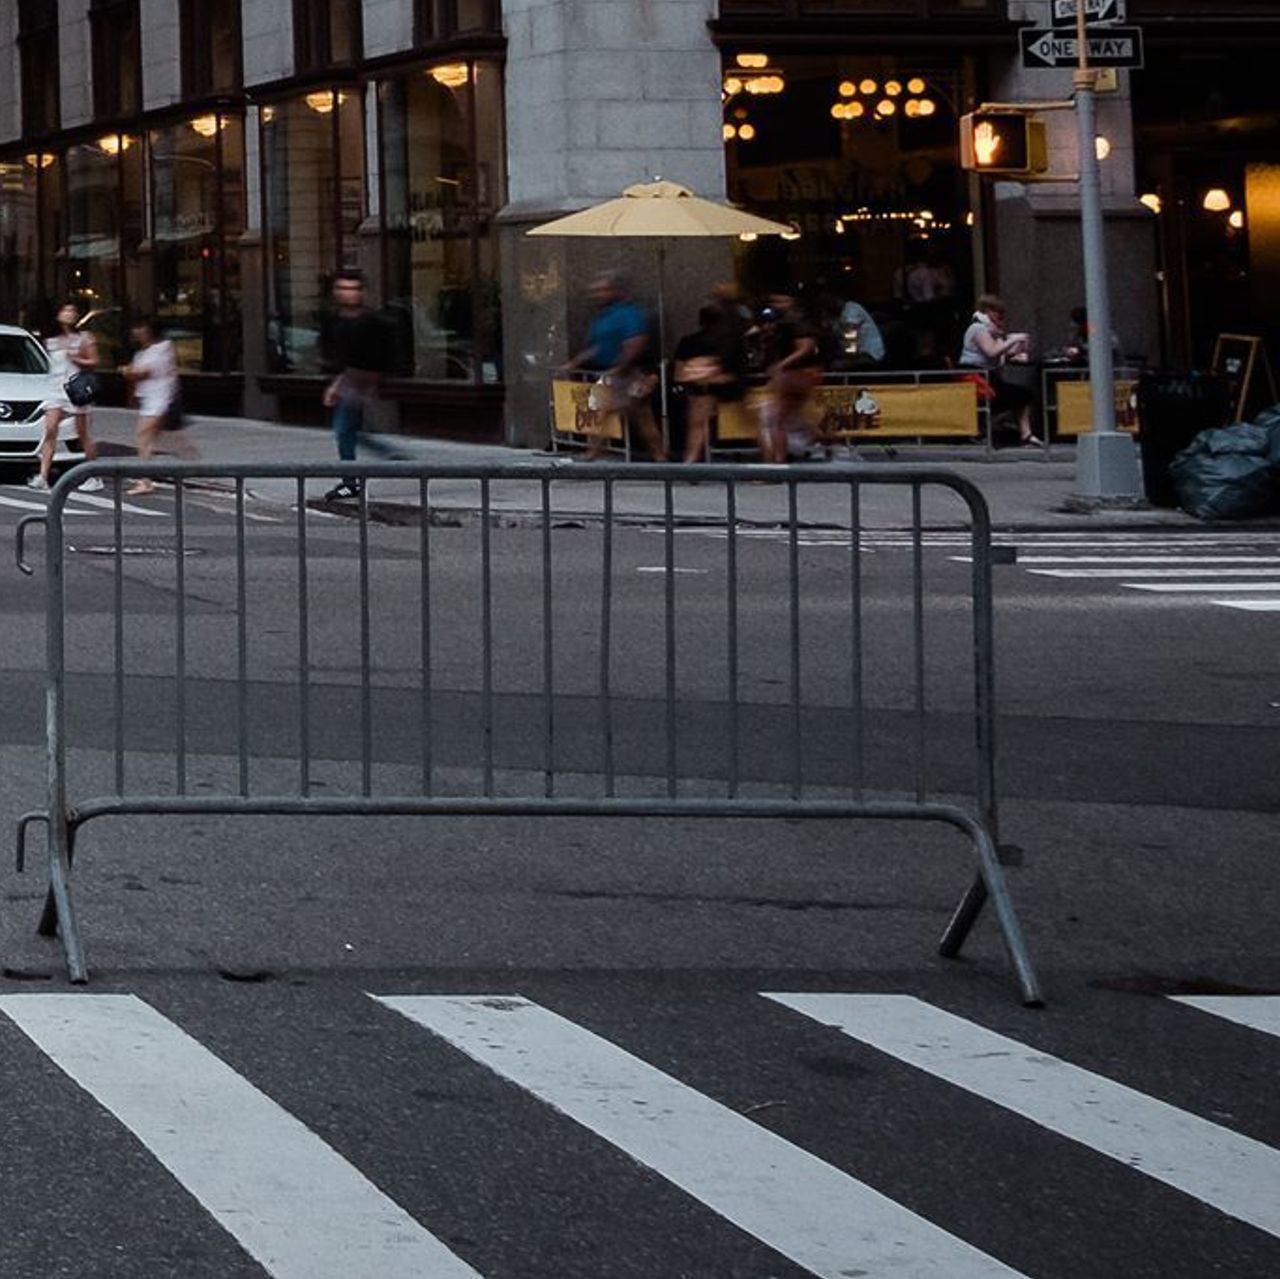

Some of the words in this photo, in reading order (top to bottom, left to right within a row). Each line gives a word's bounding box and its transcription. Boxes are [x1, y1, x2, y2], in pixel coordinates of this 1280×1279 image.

[1059, 0, 1077, 15] ONE
[1040, 41, 1073, 56] ONE
[1089, 40, 1125, 56] WAY
